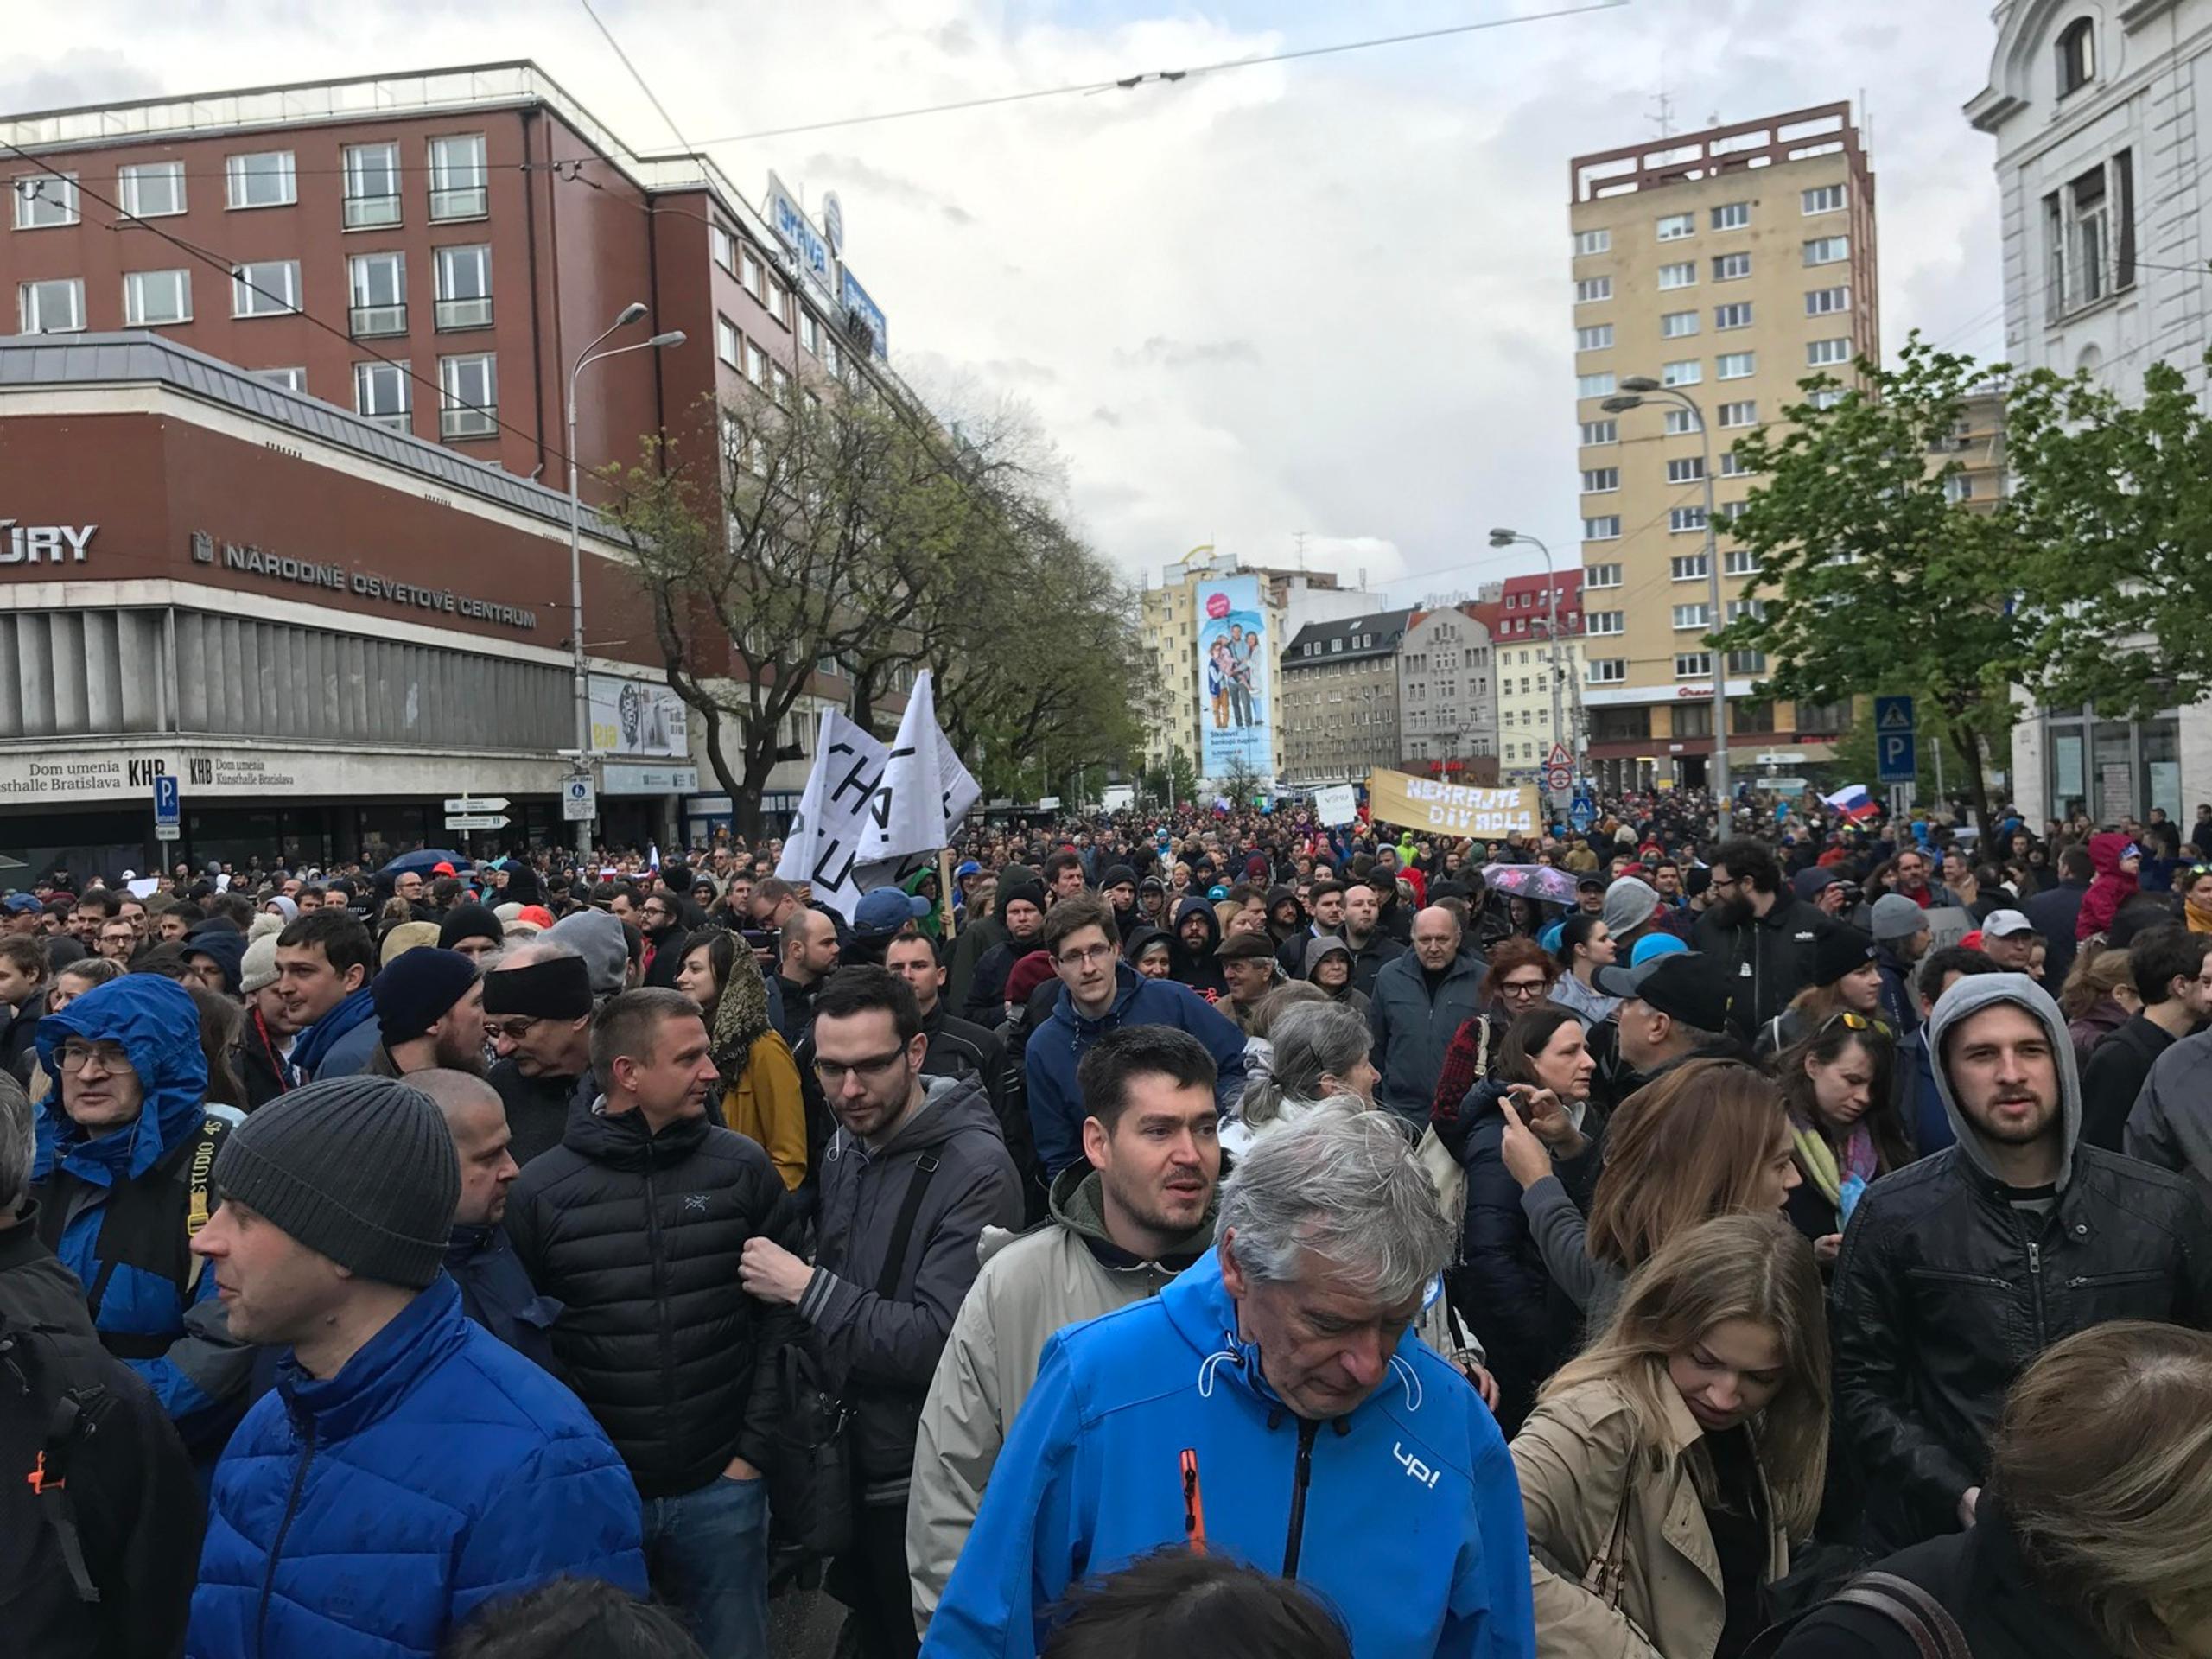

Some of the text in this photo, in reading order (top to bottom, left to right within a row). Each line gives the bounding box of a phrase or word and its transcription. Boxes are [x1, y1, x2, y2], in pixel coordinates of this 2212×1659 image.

[224, 543, 537, 628] NÁRODNÉ OSVETOVÉ CENTRUM
[216, 758, 264, 771] Dom umenia
[1887, 737, 1905, 765] P
[29, 761, 120, 776] Dom umenia
[190, 758, 213, 785] KHB
[216, 772, 294, 785] Kunsthalle Bratislava
[0, 775, 120, 793] sthalle Bratislava
[162, 779, 172, 806] P
[1407, 779, 1521, 810] NEHRAJTE
[1393, 1440, 1440, 1489] up!
